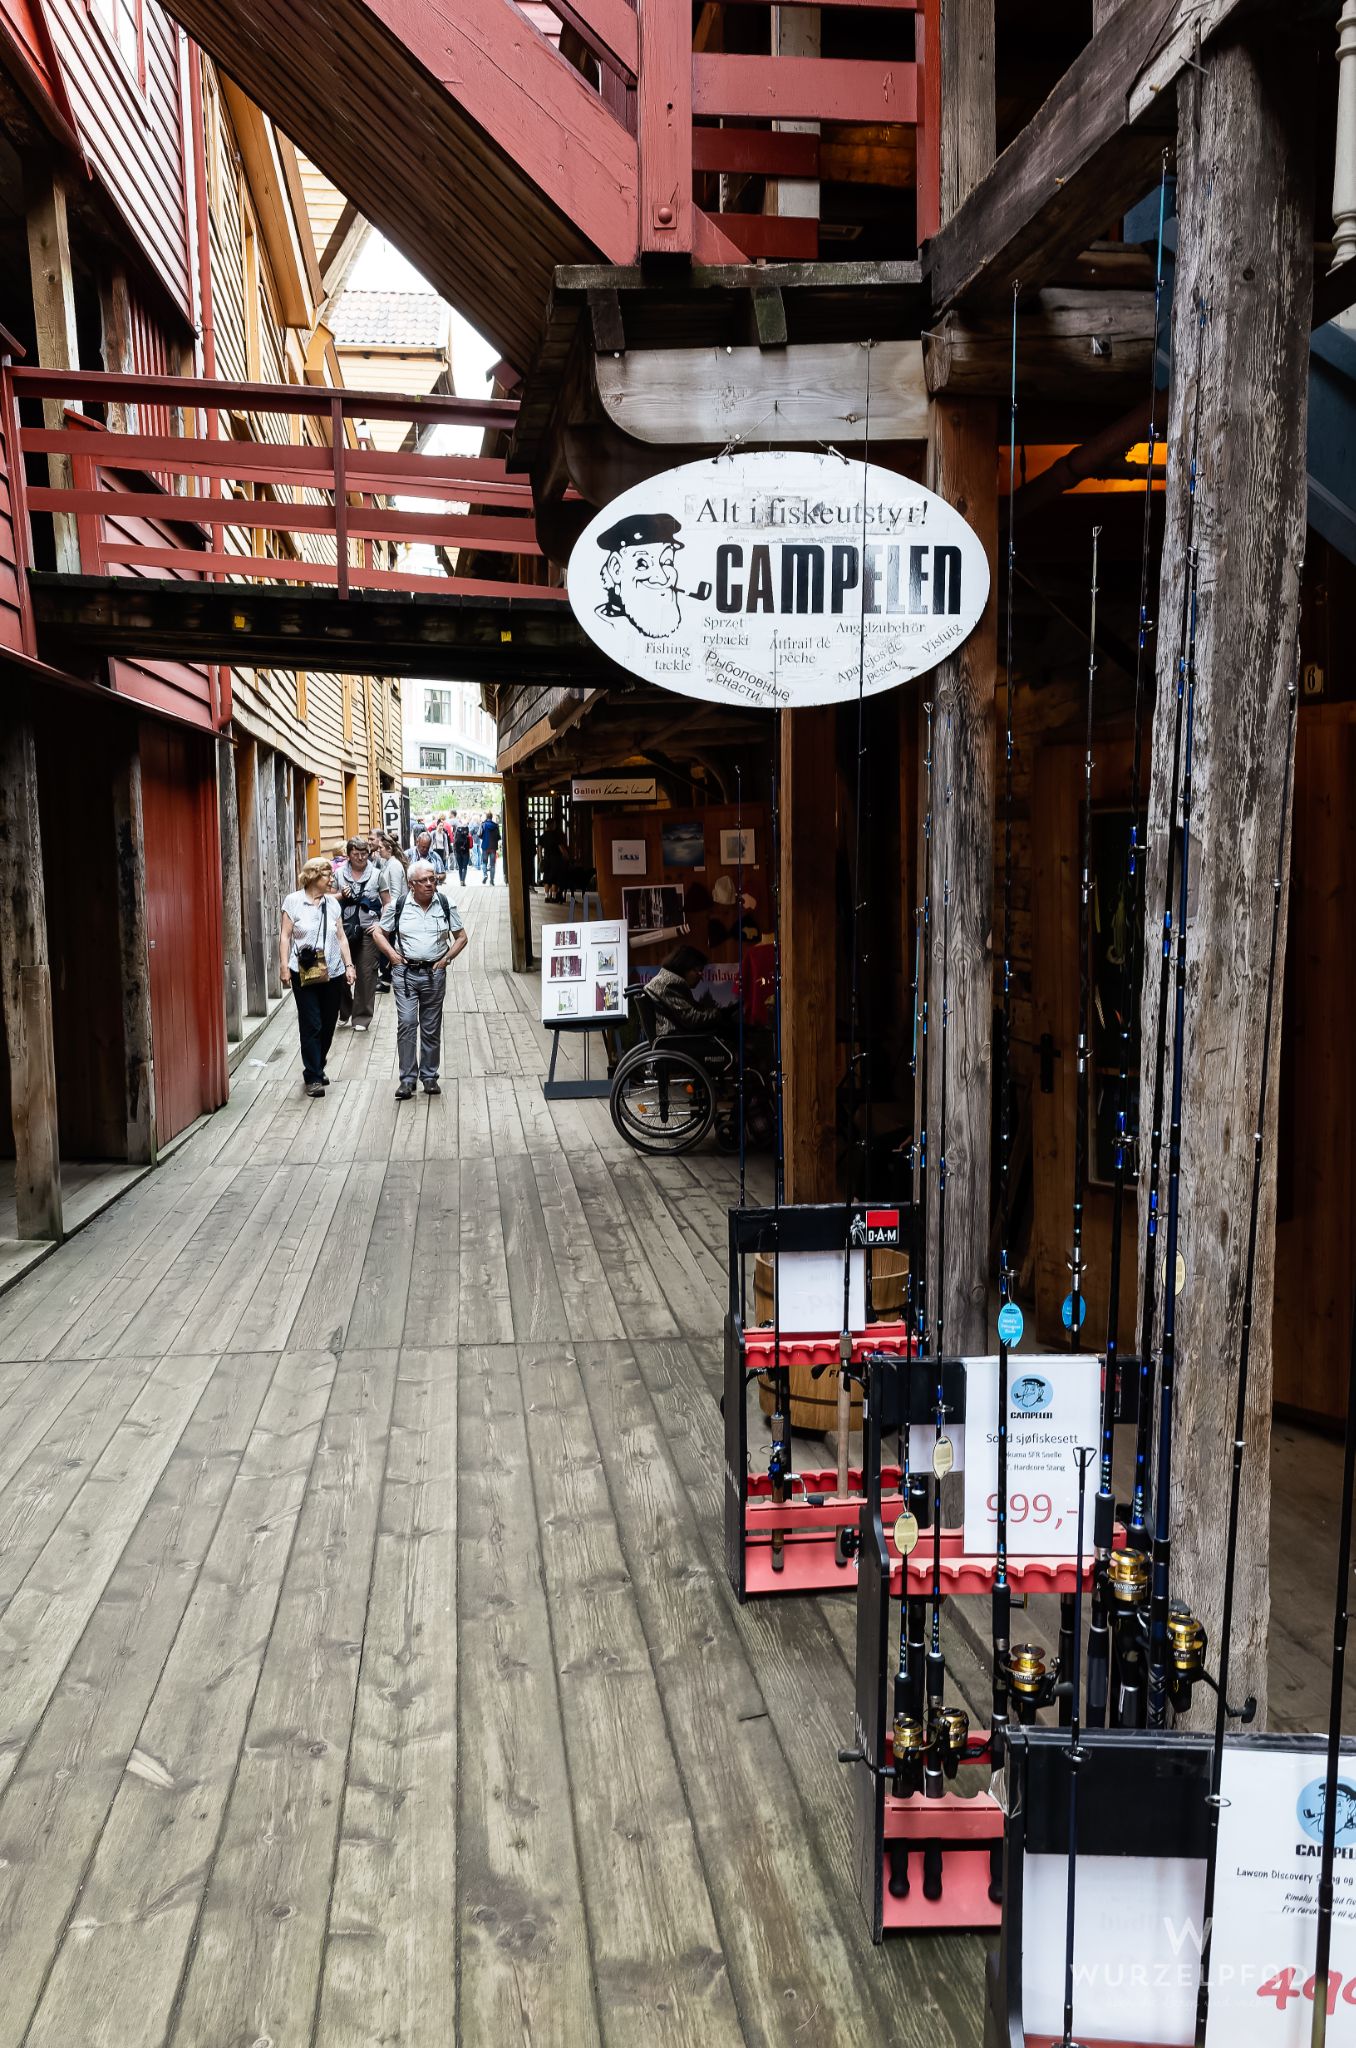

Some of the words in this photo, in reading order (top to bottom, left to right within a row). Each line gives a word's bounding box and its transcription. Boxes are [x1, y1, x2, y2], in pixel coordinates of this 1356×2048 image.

[696, 497, 740, 524] Alt
[749, 497, 758, 524] i
[766, 497, 928, 532] fiskeutstyr!
[715, 543, 962, 616] CAMPELEN
[836, 621, 926, 637] Angelzubehör
[703, 633, 749, 647] rybacki
[769, 636, 812, 650] Attirail
[816, 636, 831, 650] de
[646, 642, 691, 657] Fishing
[655, 659, 692, 671] tackle
[705, 650, 790, 702] Рыболовные
[716, 672, 762, 702] снасти
[1016, 1432, 1079, 1446] sjøfiskesett
[1271, 1868, 1313, 1885] Discovery
